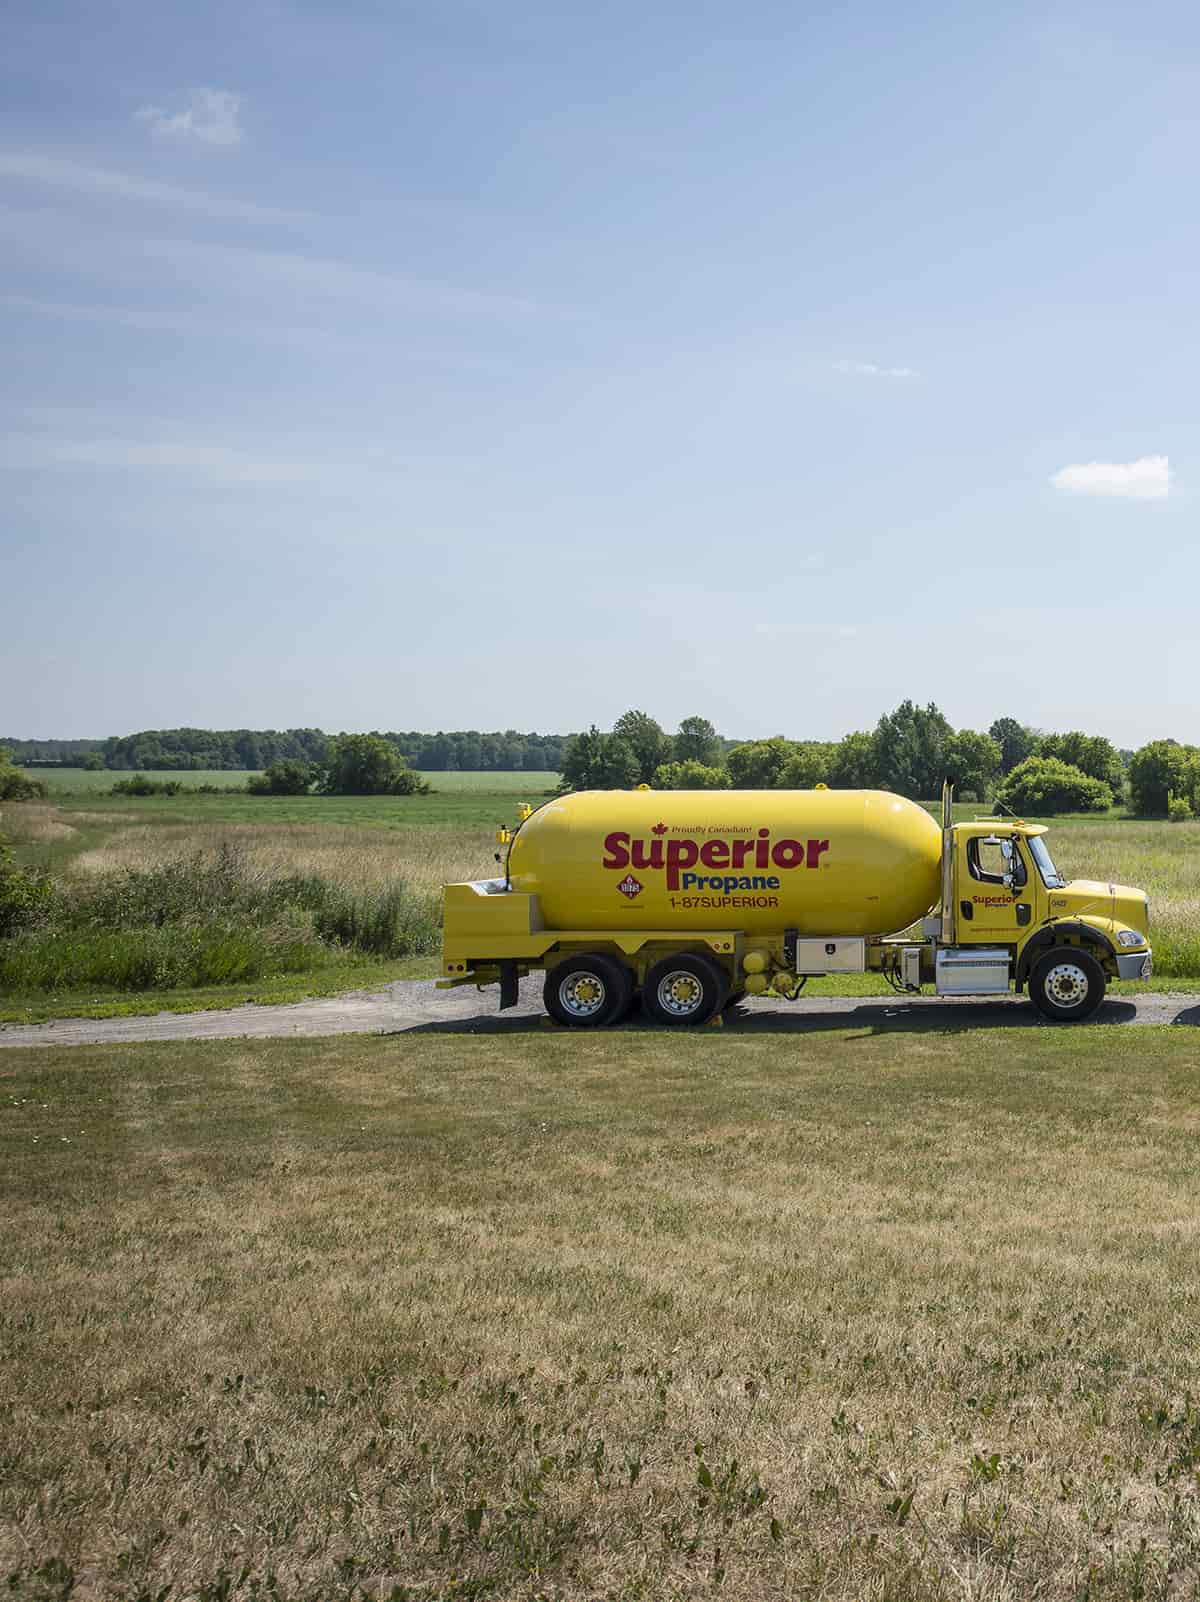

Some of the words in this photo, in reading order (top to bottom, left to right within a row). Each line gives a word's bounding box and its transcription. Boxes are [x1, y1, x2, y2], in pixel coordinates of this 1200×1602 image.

[672, 824, 706, 835] Proudly
[602, 828, 829, 891] Superior
[682, 873, 780, 894] Propane
[671, 897, 779, 909] 1-87SUPERIOR
[972, 894, 1018, 908] Superior
